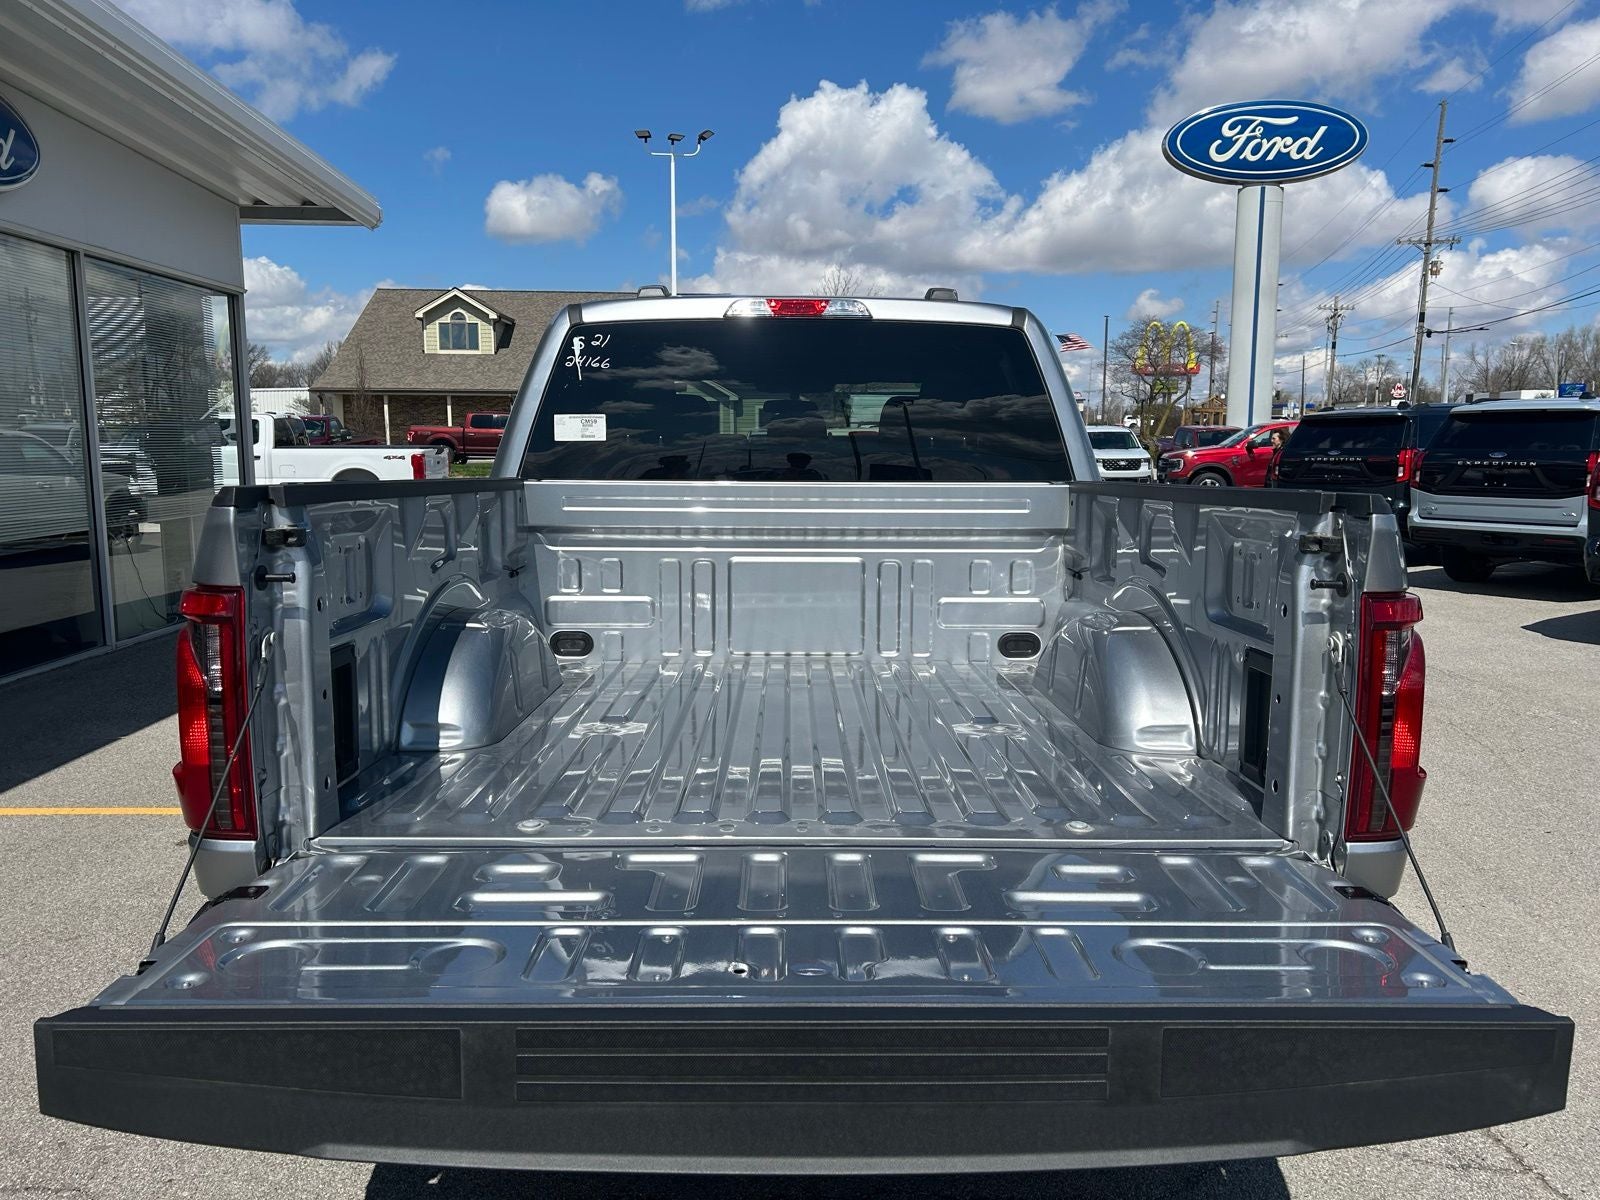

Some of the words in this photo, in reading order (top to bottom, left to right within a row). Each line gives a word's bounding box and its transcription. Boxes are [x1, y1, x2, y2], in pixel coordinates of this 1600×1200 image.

[1209, 115, 1328, 162] Ford
[591, 334, 611, 348] 21
[565, 355, 610, 369] 24166
